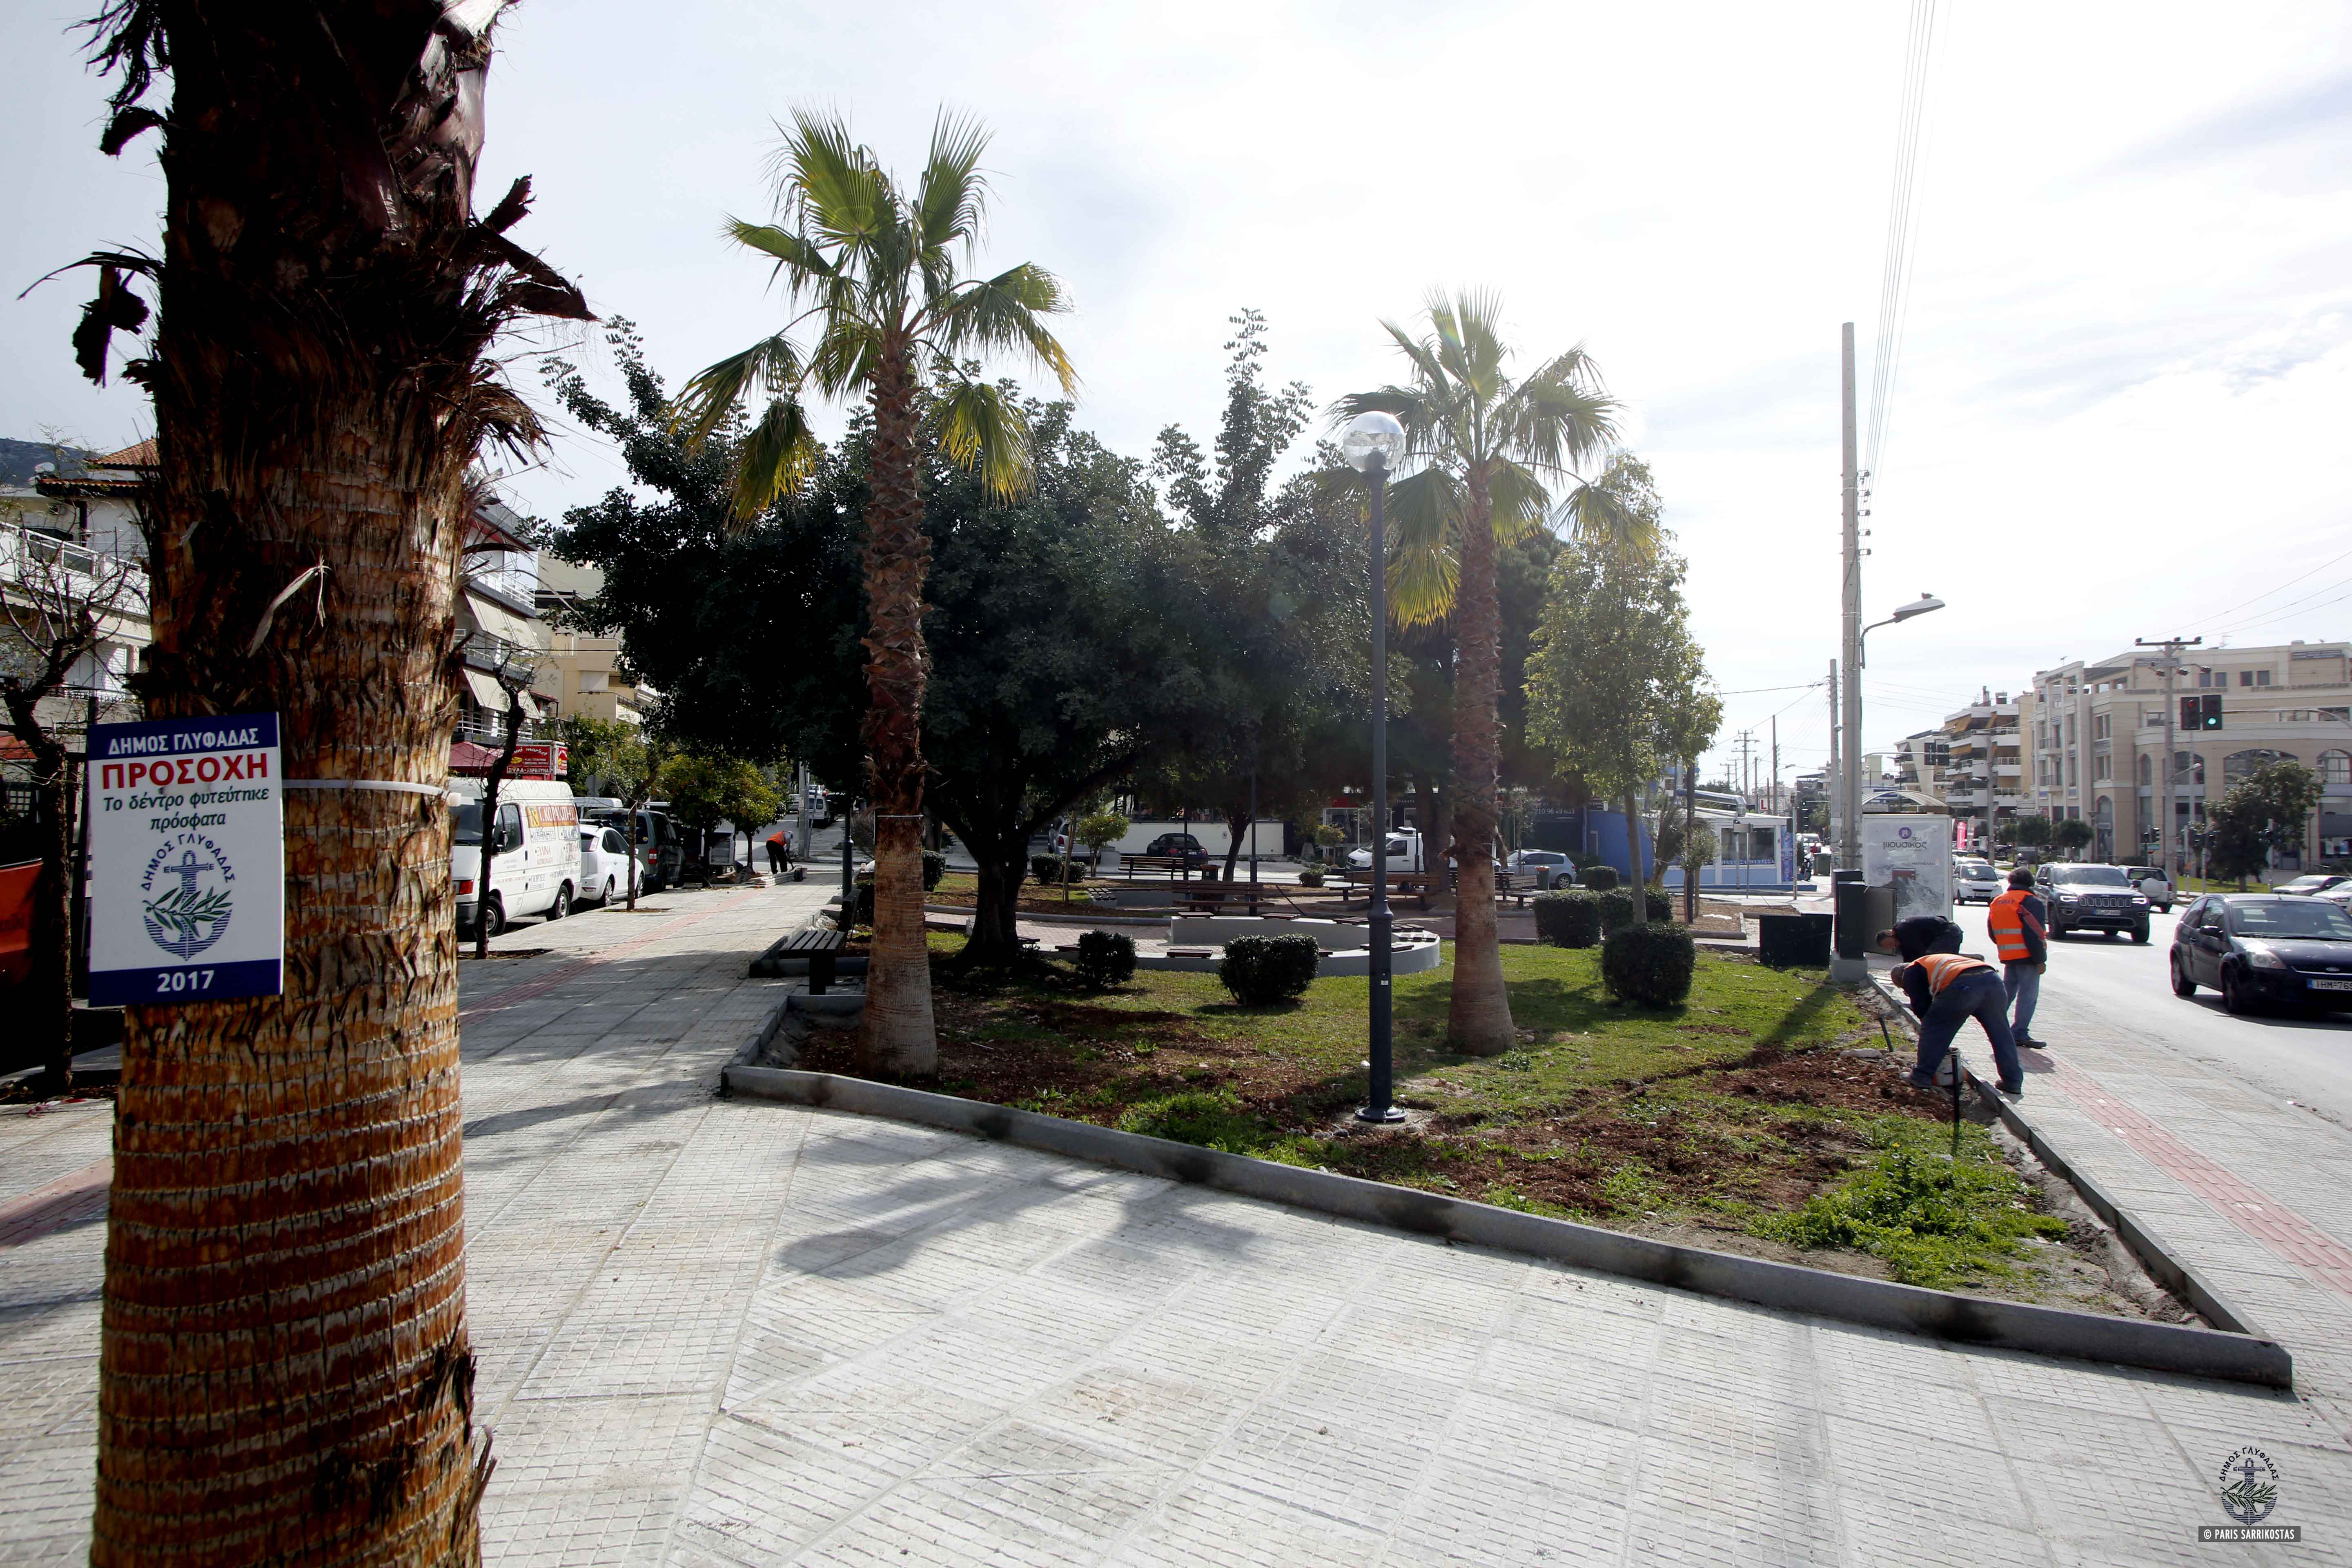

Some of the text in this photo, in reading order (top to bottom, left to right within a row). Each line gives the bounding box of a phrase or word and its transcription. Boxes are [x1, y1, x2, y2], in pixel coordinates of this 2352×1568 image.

[108, 728, 259, 755] ΔΗΜΟΣ ΓΛΥΦΑΔΑΣ
[102, 752, 267, 790] ΠΡΟΣΟΧΗ
[104, 786, 270, 811] Το δέντρο φυτεύτηκε
[150, 812, 226, 833] πρόσφατα
[141, 833, 236, 891] ΔΗΜΟΣ ΓΛΥΦΑΔΑΣ
[156, 971, 215, 993] 2017
